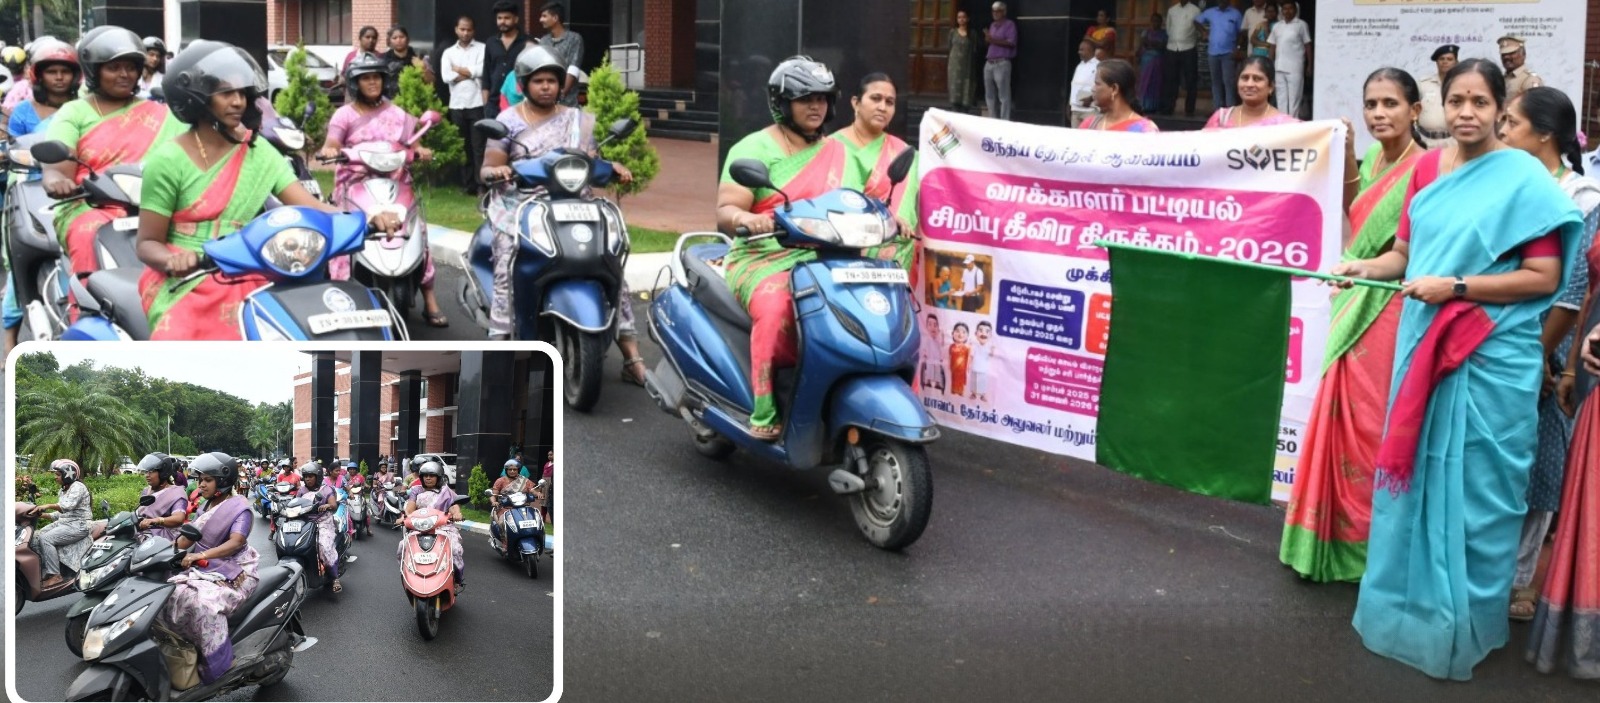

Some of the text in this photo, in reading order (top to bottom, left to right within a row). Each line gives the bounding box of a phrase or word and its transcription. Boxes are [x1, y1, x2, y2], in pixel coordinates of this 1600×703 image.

[1034, 144, 1094, 165] தேர்தல்
[1226, 147, 1318, 172] SWEEP
[986, 182, 1243, 223] வாக்காளர் பட்டியல்
[928, 206, 1000, 240] சிறப்பு
[1003, 212, 1075, 247] தீவிர
[1216, 237, 1309, 267] 2026
[1034, 331, 1055, 341] 2025
[1030, 391, 1040, 400] 31
[1069, 399, 1093, 410] 2026
[1066, 389, 1089, 400] 2025
[923, 396, 1097, 446] மாவட்ட தேர்தல் அலுவலர் மற்றும்
[1276, 440, 1297, 453] 50
